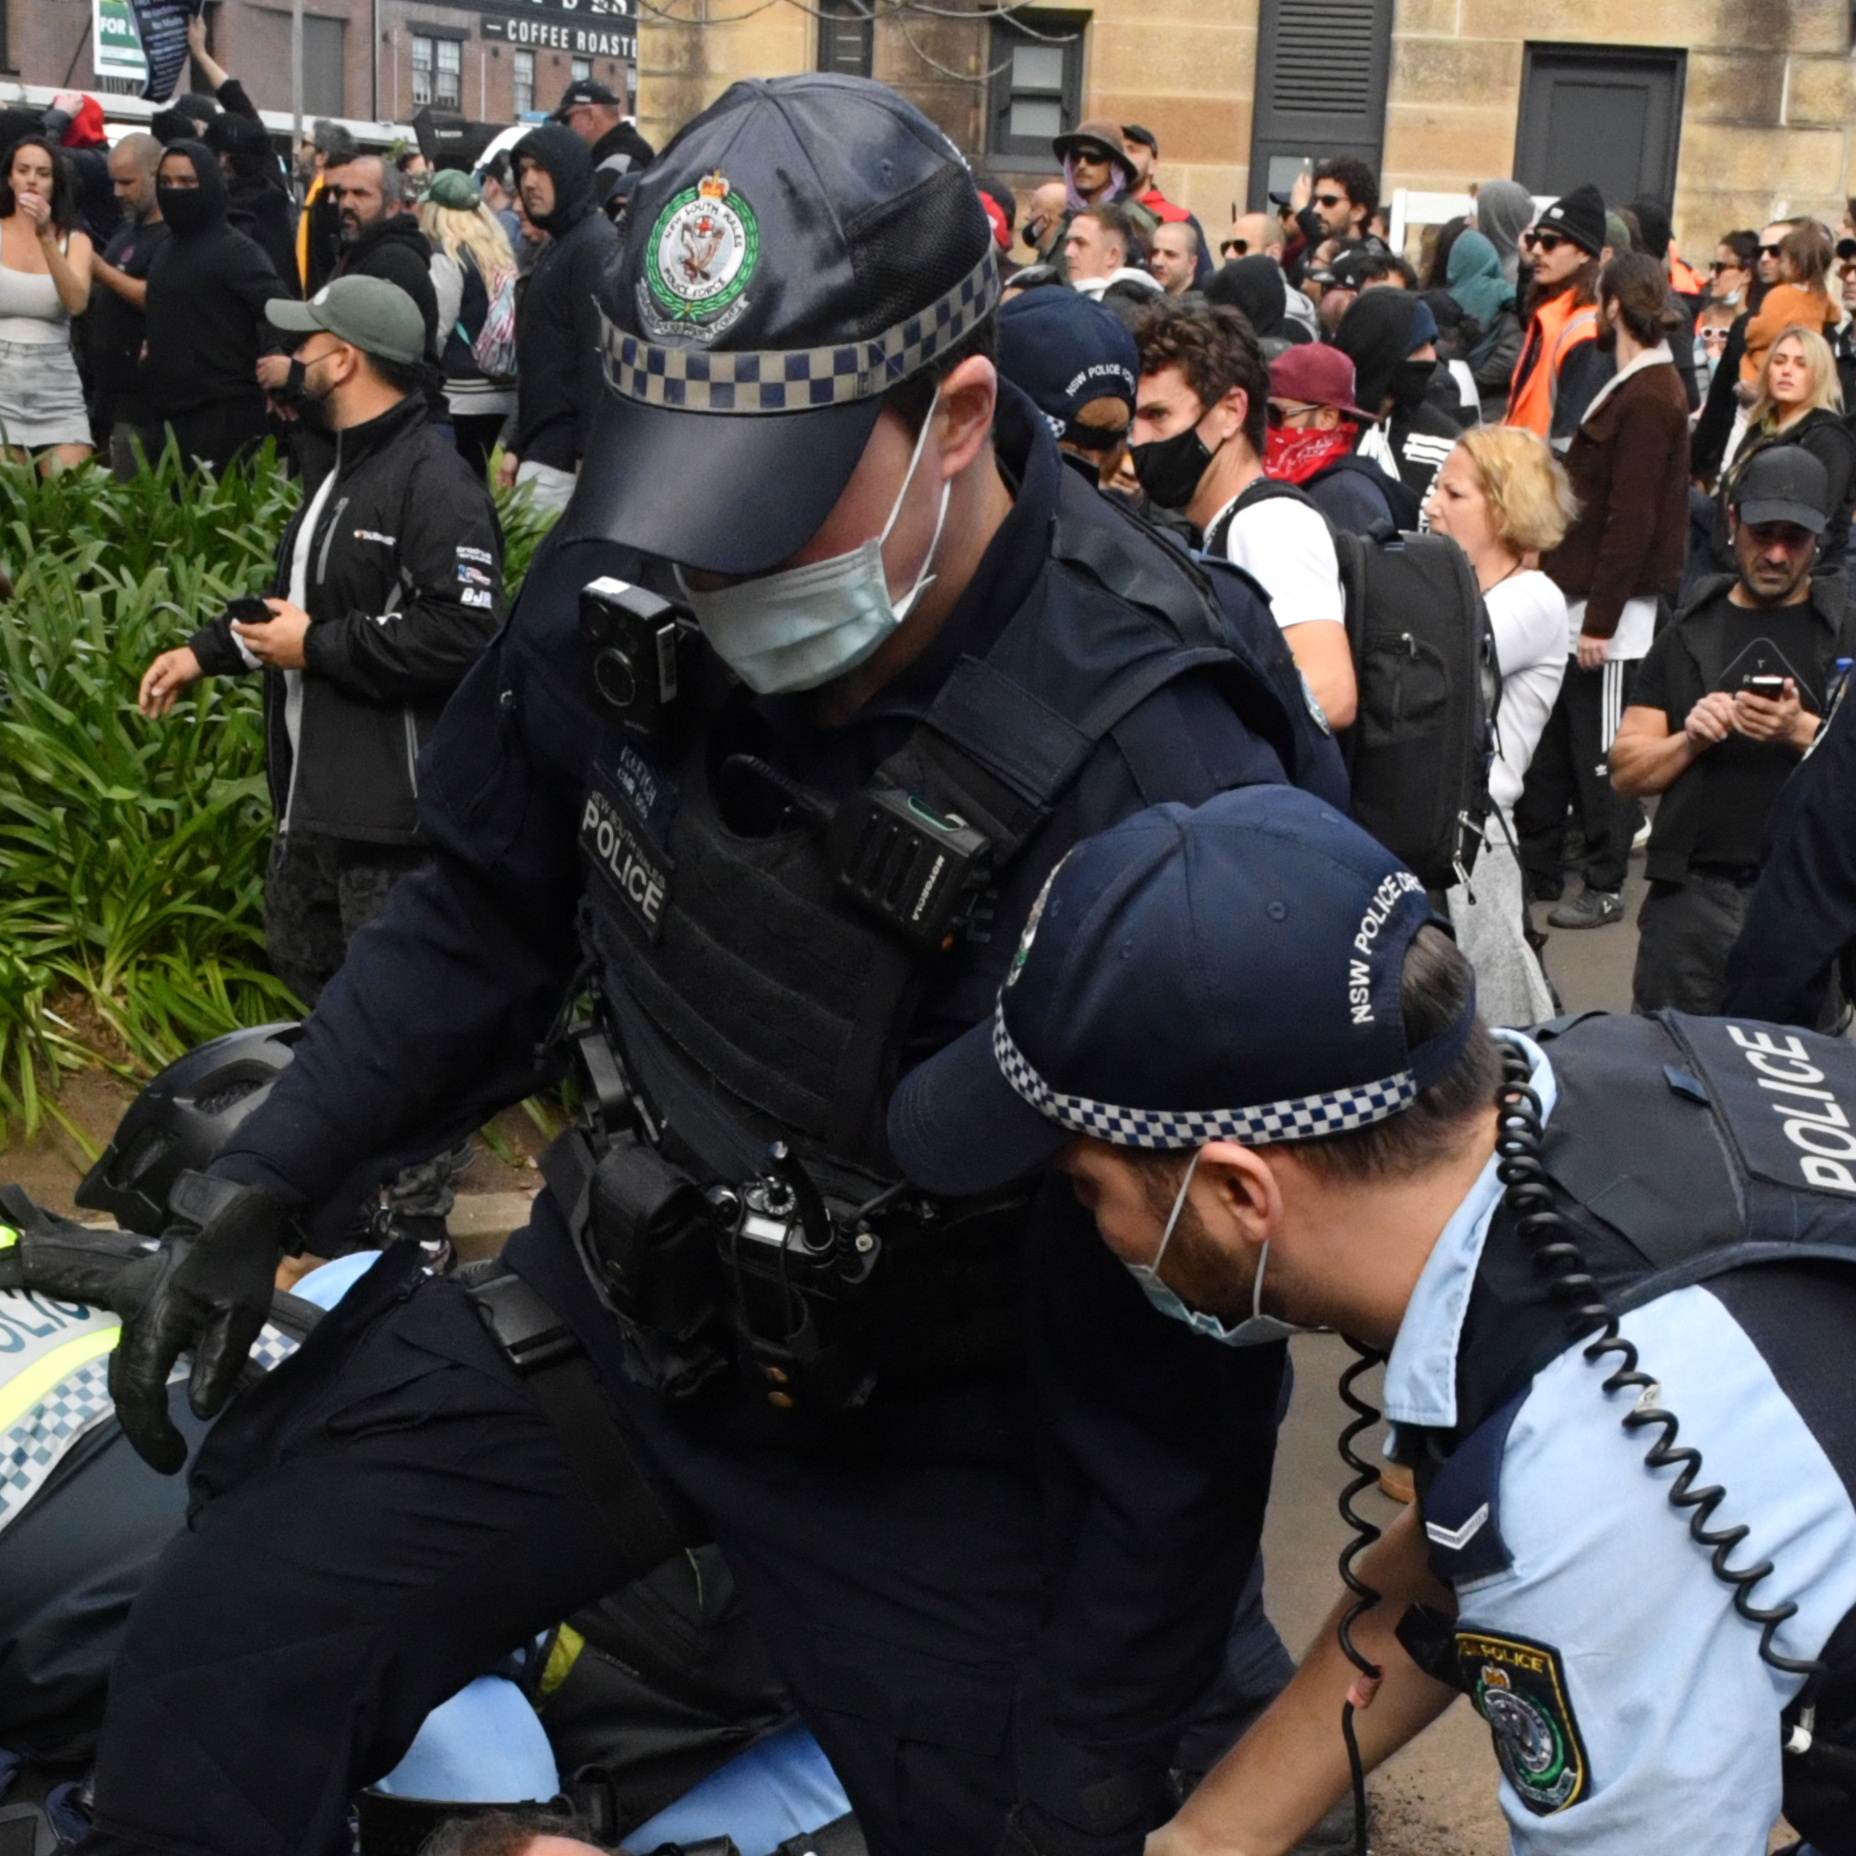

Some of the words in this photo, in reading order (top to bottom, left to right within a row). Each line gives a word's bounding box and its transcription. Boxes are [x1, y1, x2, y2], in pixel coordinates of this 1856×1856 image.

[100, 16, 126, 35] FOR
[507, 19, 569, 48] COFFEE
[685, 201, 720, 217] SOUTH
[722, 213, 744, 248] WALES
[1065, 371, 1087, 397] NSW
[1088, 363, 1120, 379] POLICE
[582, 799, 664, 924] POLICE
[912, 854, 945, 920] MOTOROLA
[1354, 874, 1402, 955] POLICE
[1348, 958, 1376, 1025] NSW
